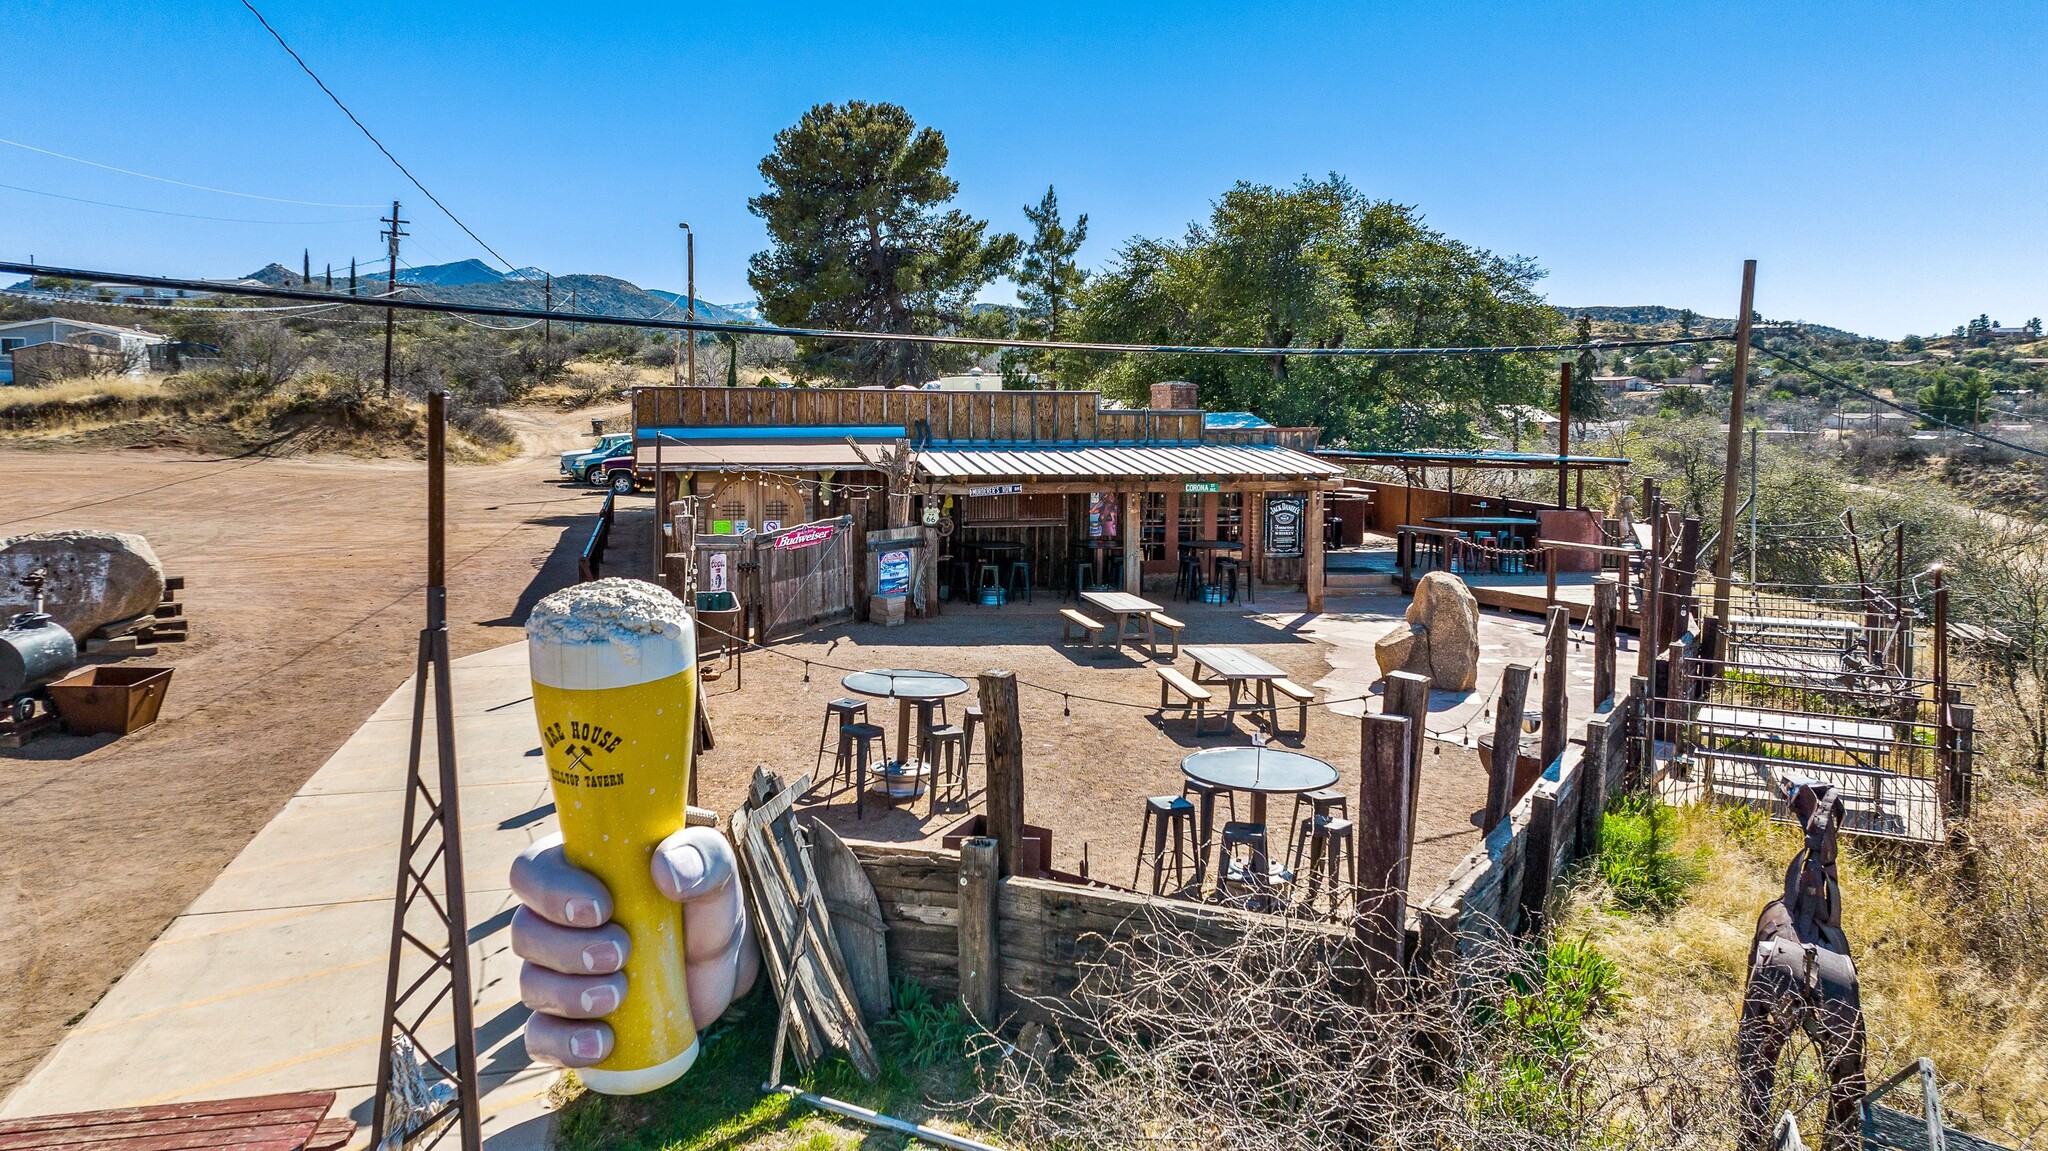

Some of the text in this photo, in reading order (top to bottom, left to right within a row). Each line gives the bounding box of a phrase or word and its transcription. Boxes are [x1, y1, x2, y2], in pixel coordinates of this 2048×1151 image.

[1185, 484, 1208, 492] CORONA
[1270, 504, 1282, 515] JACK
[926, 515, 936, 523] 66
[780, 530, 830, 547] Budweiser
[571, 721, 623, 753] HOUSE
[584, 772, 624, 788] TAVERN
